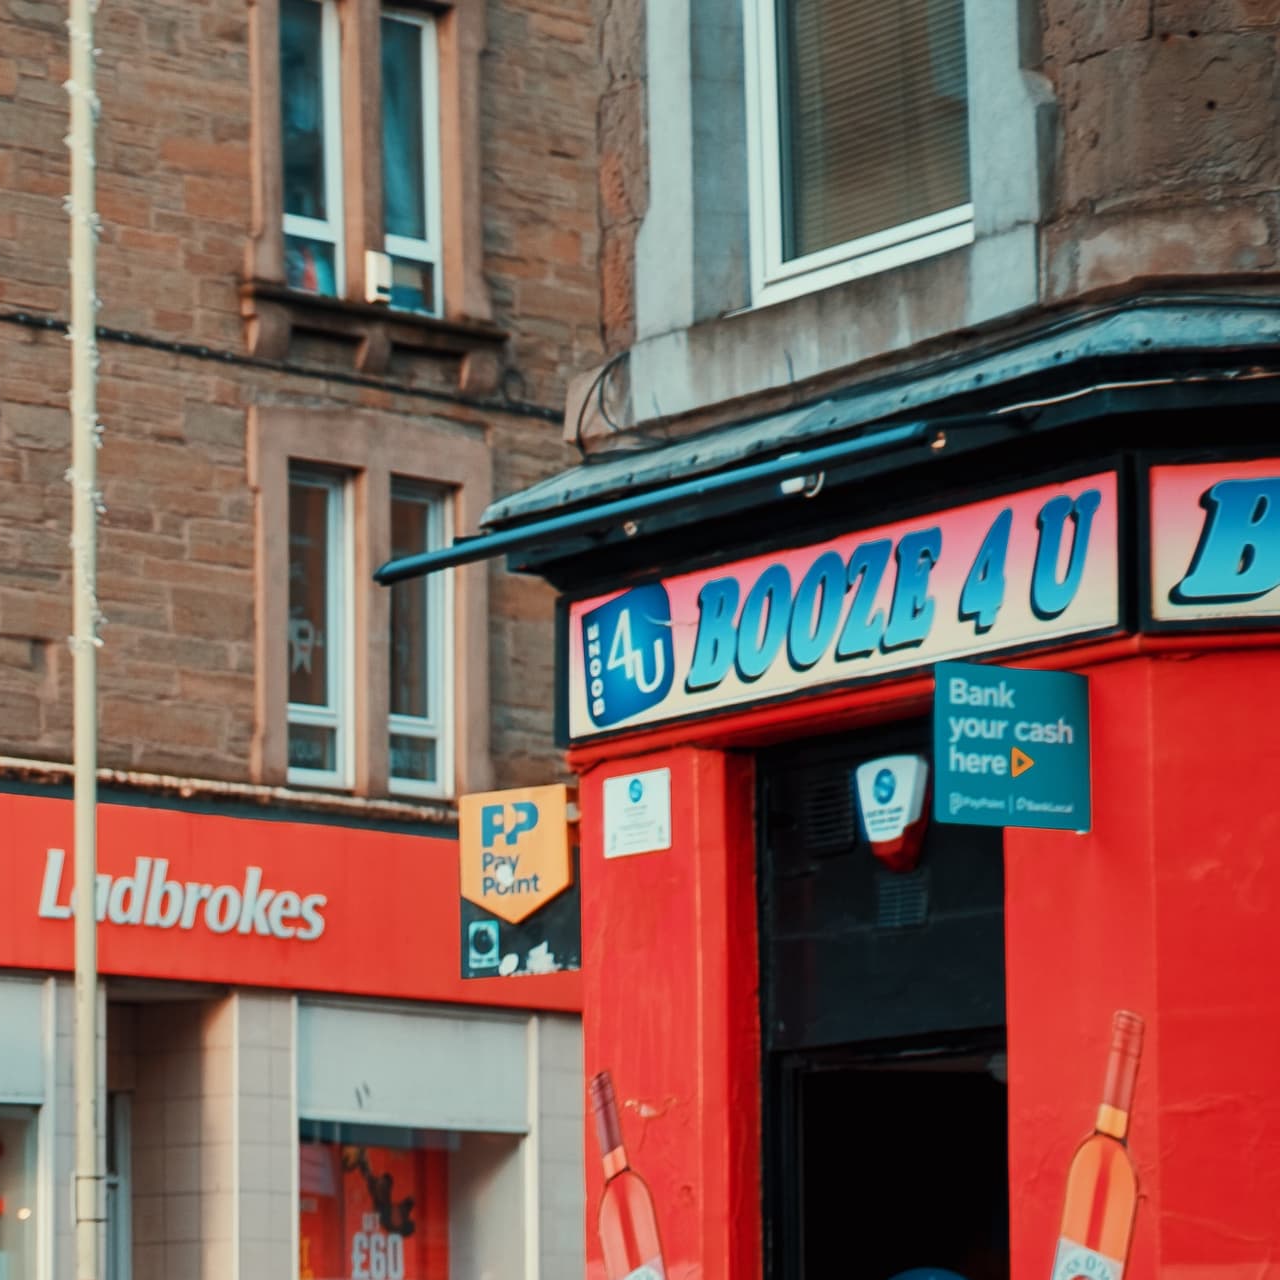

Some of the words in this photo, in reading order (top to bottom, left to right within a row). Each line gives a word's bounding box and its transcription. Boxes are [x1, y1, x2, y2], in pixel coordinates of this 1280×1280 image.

[685, 526, 942, 694] BOOZE
[959, 507, 1013, 634] 4
[1030, 489, 1102, 621] U
[587, 623, 605, 717] BOOZE
[949, 677, 1015, 708] Bank
[949, 717, 1009, 744] your
[1014, 717, 1073, 745] cash
[949, 744, 1007, 775] here
[352, 1232, 404, 1280] £60
